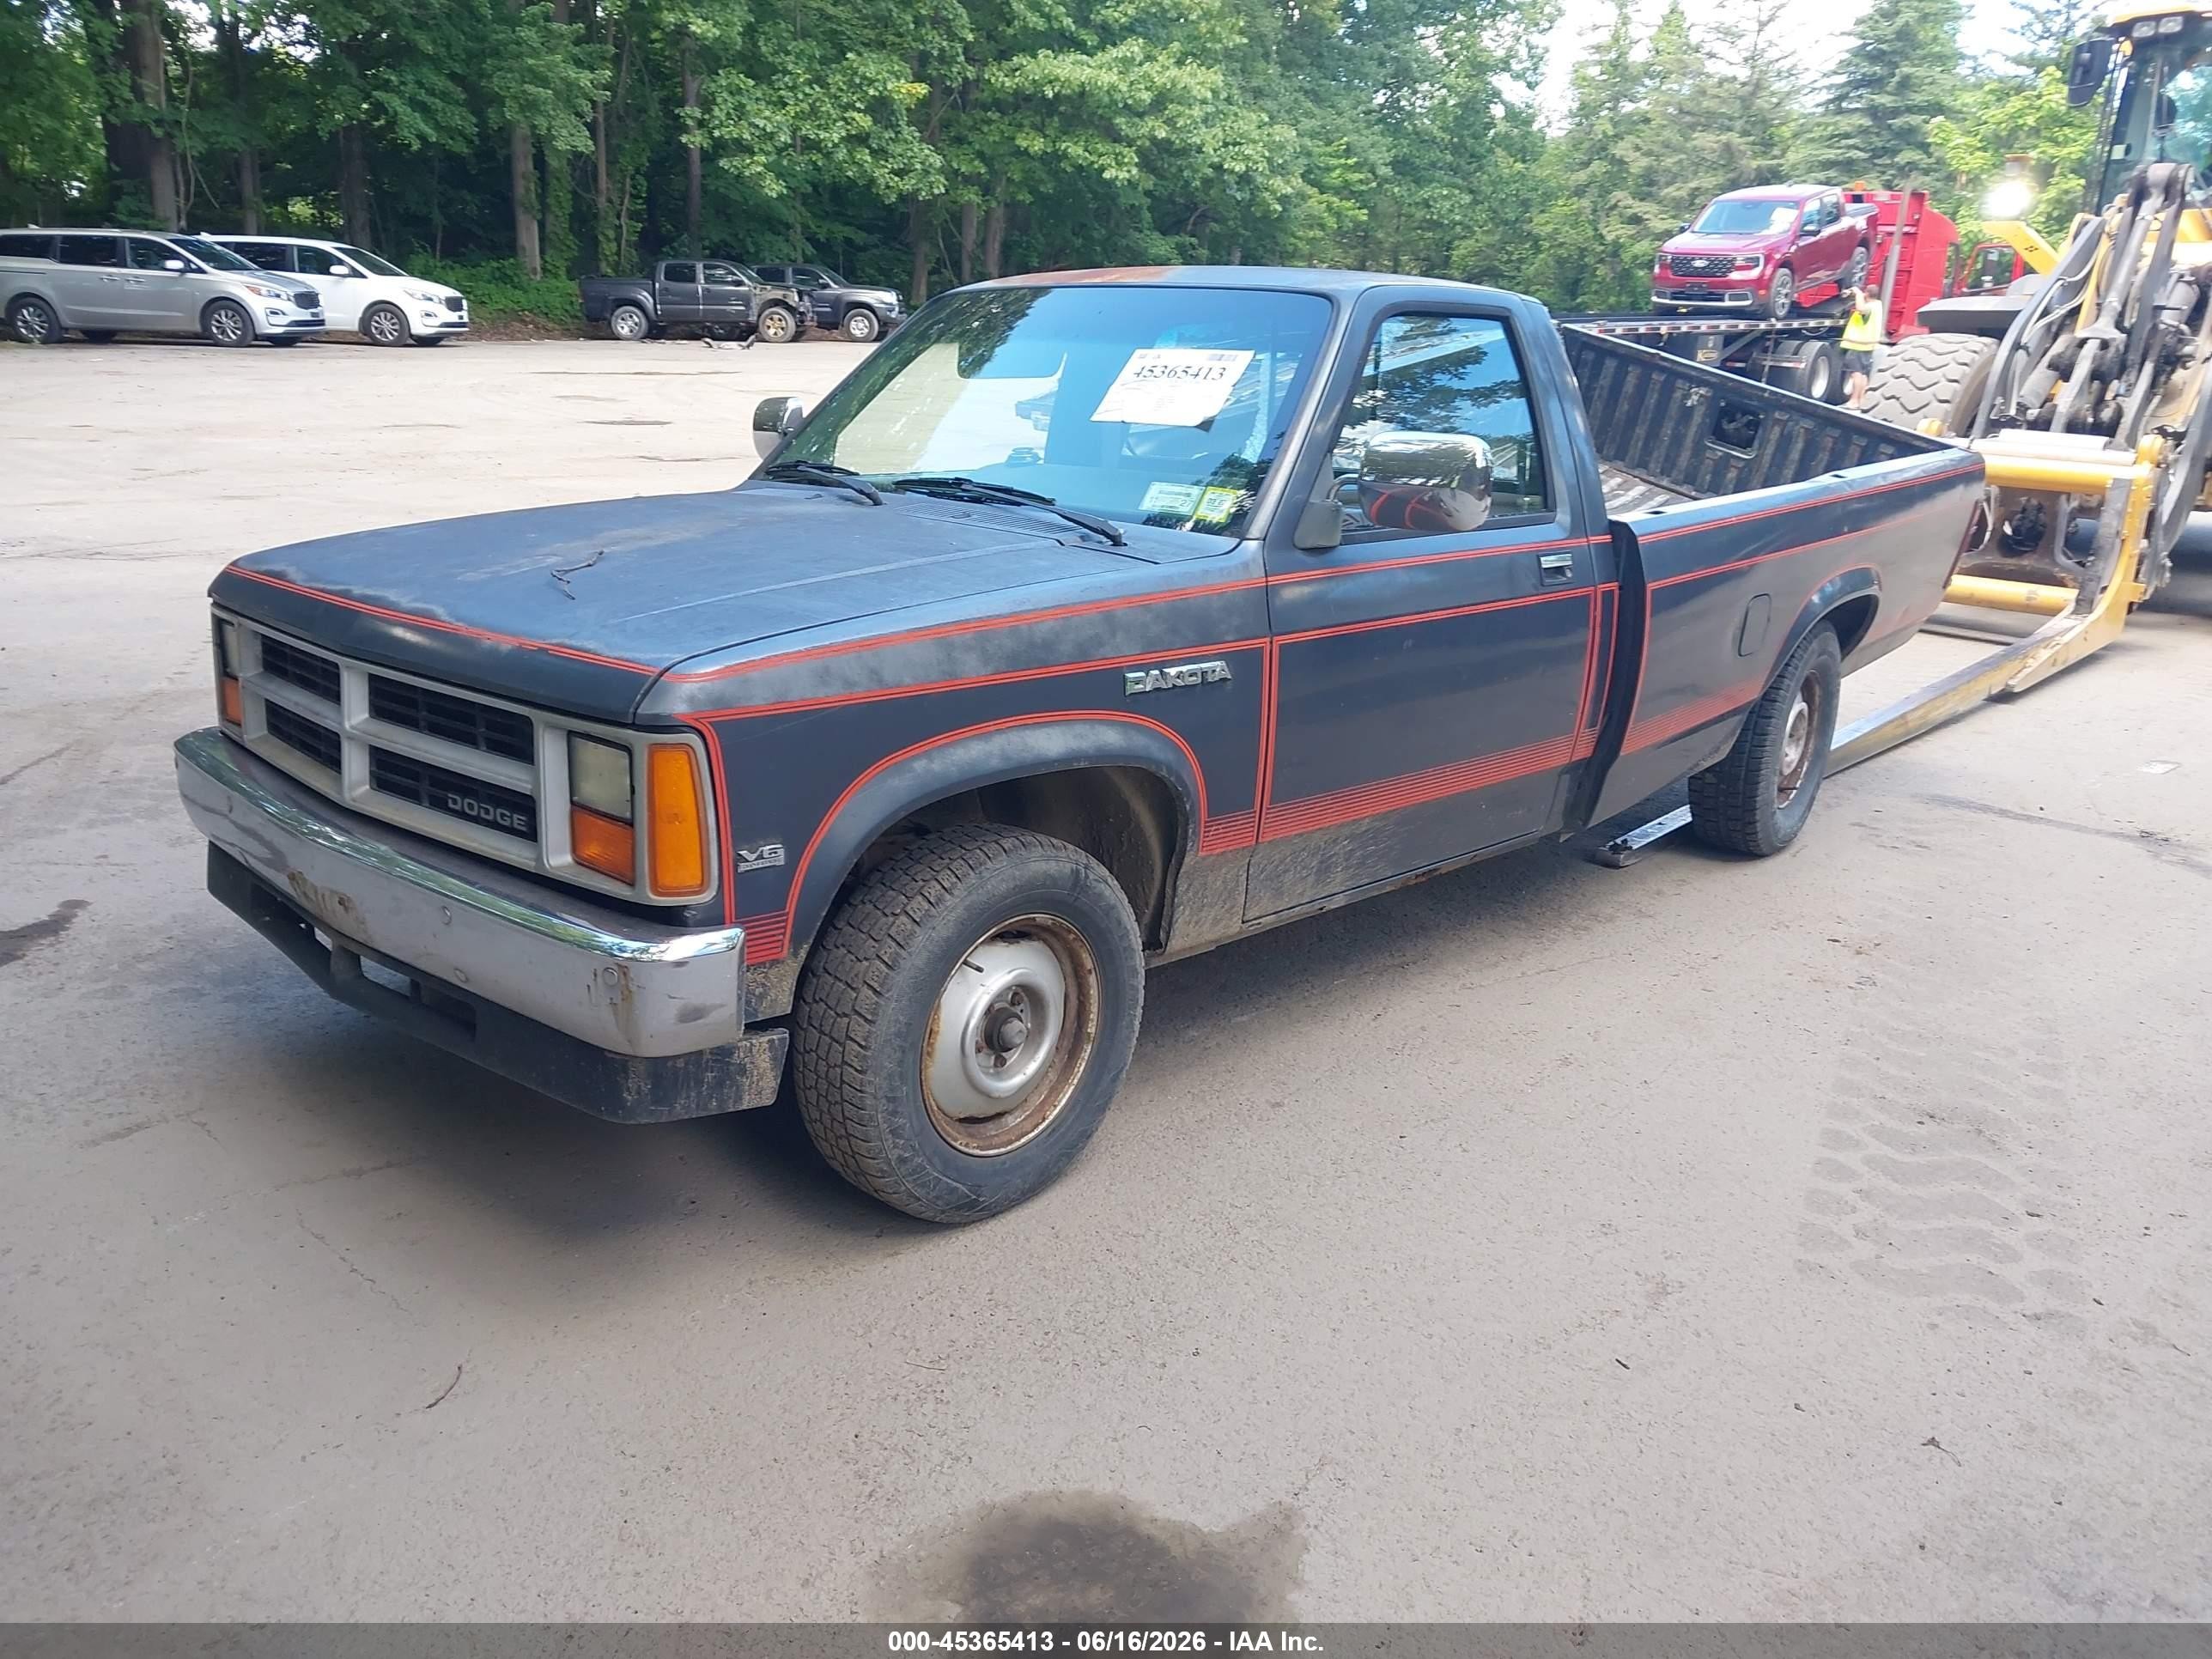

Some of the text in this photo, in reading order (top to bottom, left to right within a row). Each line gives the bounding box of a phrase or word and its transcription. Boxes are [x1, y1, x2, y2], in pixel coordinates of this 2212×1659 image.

[1133, 364, 1226, 380] 45365413
[1124, 660, 1232, 696] DAKOTA
[447, 793, 530, 831] DODGE
[737, 843, 785, 861] V6
